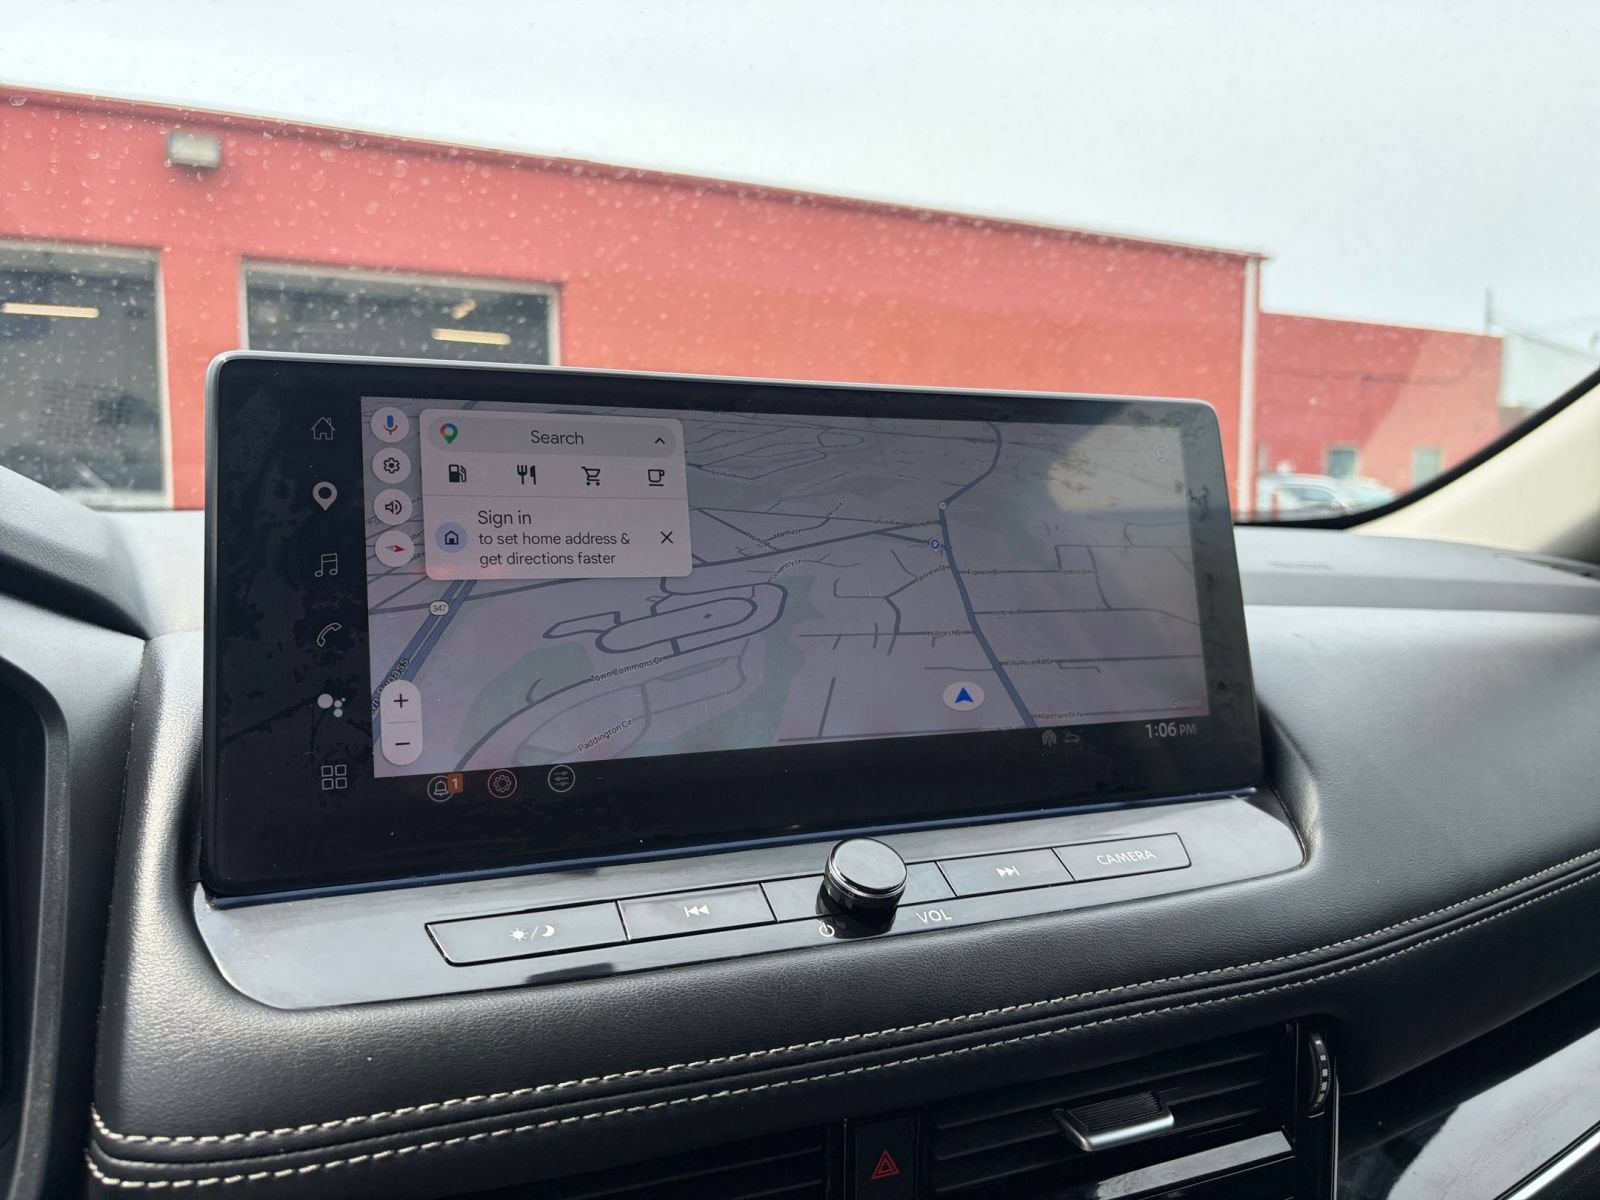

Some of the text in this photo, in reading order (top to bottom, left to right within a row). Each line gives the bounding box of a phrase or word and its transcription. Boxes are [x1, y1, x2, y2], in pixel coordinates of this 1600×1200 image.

[530, 429, 584, 446] Search
[477, 509, 532, 529] Sign in
[478, 531, 631, 546] to set home address &
[479, 551, 617, 569] get directions faster
[769, 560, 795, 580] Coventry
[432, 604, 447, 613] 347
[590, 670, 613, 682] Town
[611, 659, 654, 676] Commons
[577, 724, 622, 752] Paddington
[1144, 721, 1197, 739] 1:06 PM
[1096, 849, 1157, 866] CAMERA
[914, 908, 953, 924] VOL
